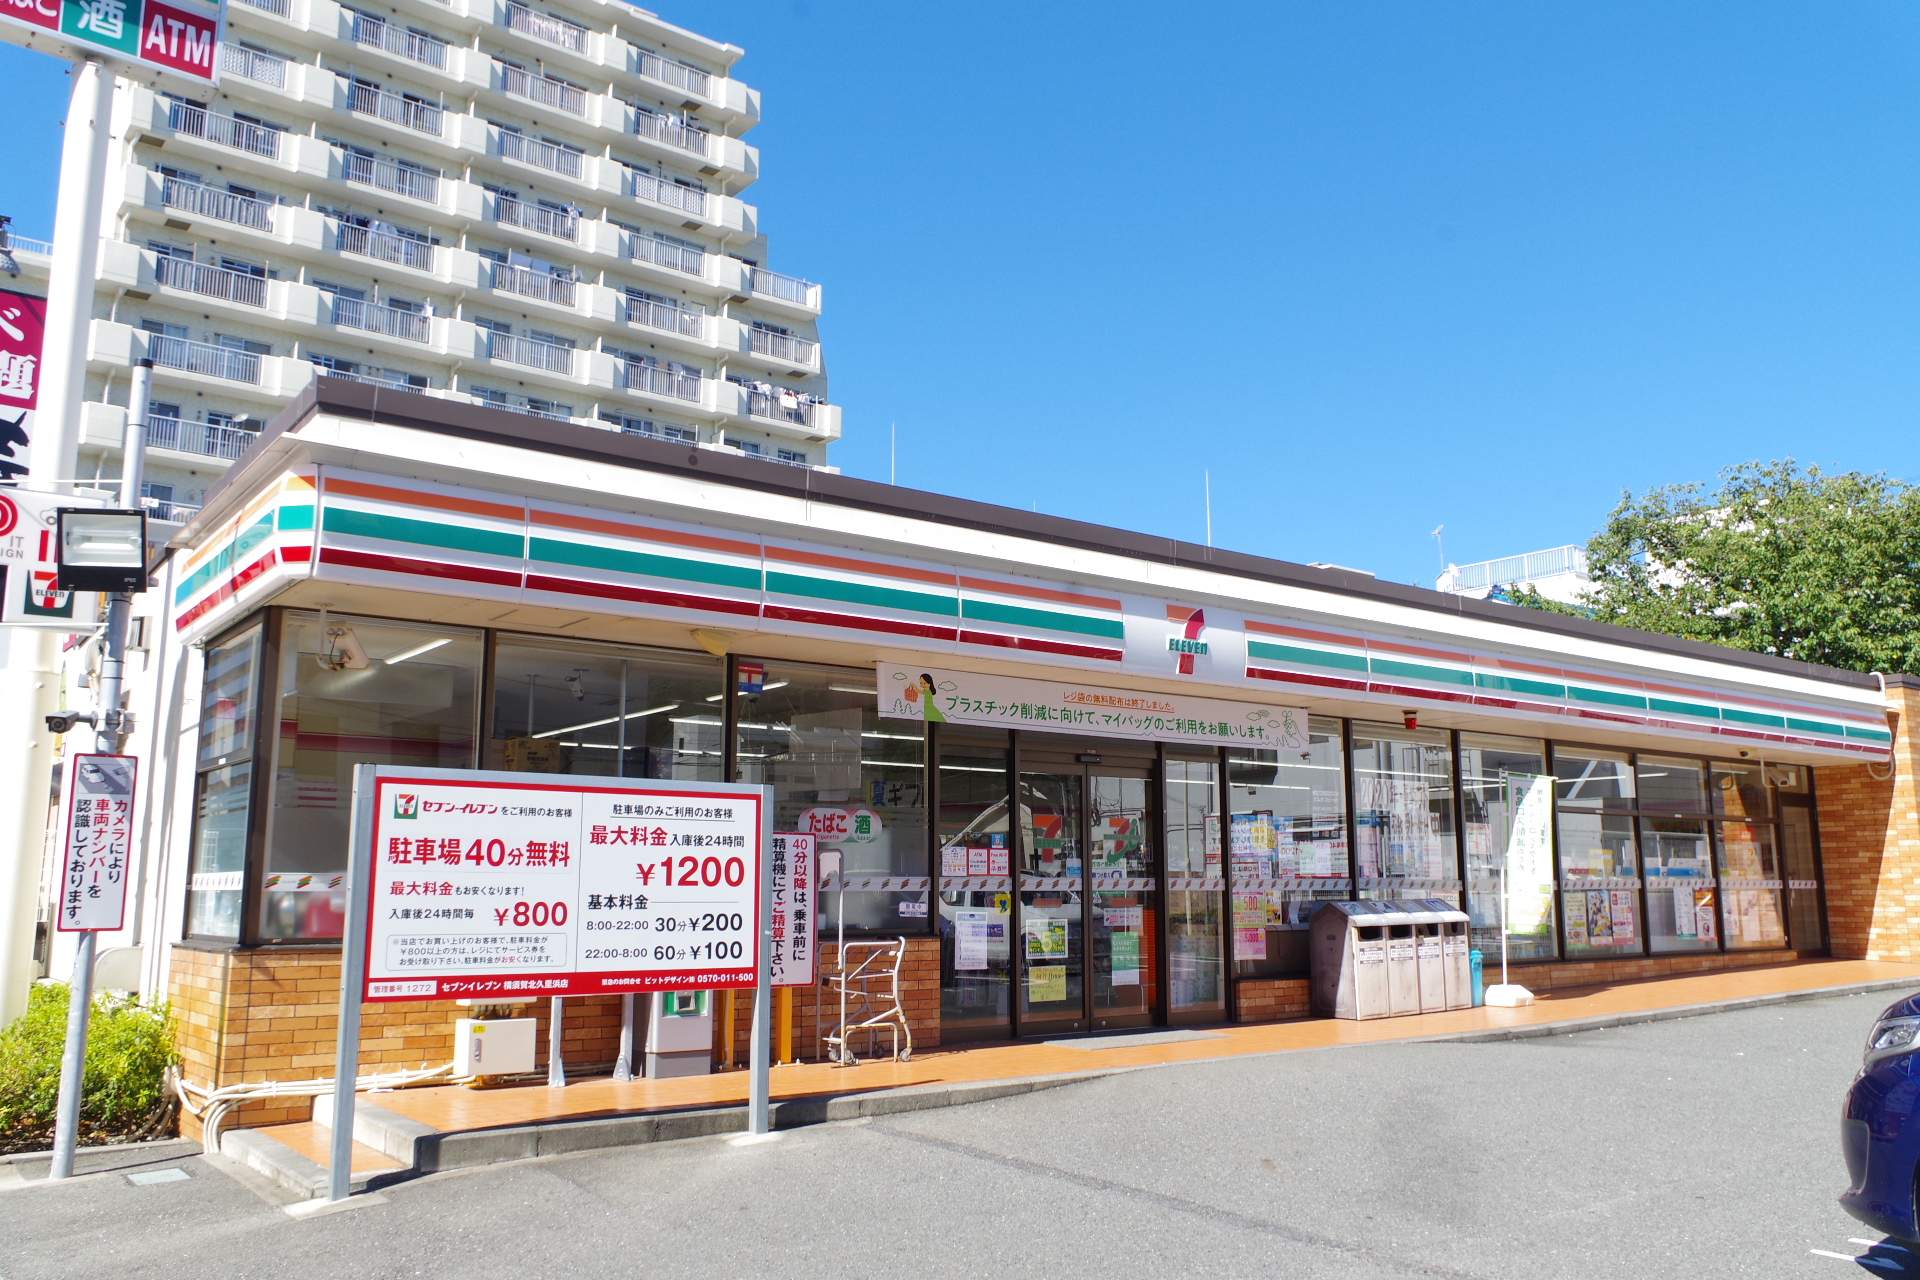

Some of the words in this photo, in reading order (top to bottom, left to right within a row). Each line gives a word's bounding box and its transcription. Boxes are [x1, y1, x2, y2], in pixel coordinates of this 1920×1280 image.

[77, 0, 127, 40] 酒
[145, 13, 211, 67] ATM
[501, 806, 573, 818] をご利用のお客様
[612, 803, 734, 819] 駐車場のみご利用のお客様
[809, 812, 848, 833] たばこ
[855, 815, 871, 834] 酒
[87, 799, 110, 899] 車両ナンバーを
[108, 800, 128, 883] カメラにより
[388, 836, 570, 868] 駐車場40分無料
[66, 799, 92, 926] 認識しております。
[588, 894, 649, 911] 基本料金
[792, 838, 808, 961] 40分以降は、乗車前に
[389, 908, 474, 920] 入庫後24時間毎
[770, 838, 787, 983] 精算機にてご精算下さい。
[586, 920, 649, 931] 8:00-22:00
[585, 948, 648, 959] 22:00-8:00
[441, 982, 502, 993] セブンイレブン
[697, 972, 754, 984] 0570-011-500
[407, 984, 432, 993] 1272
